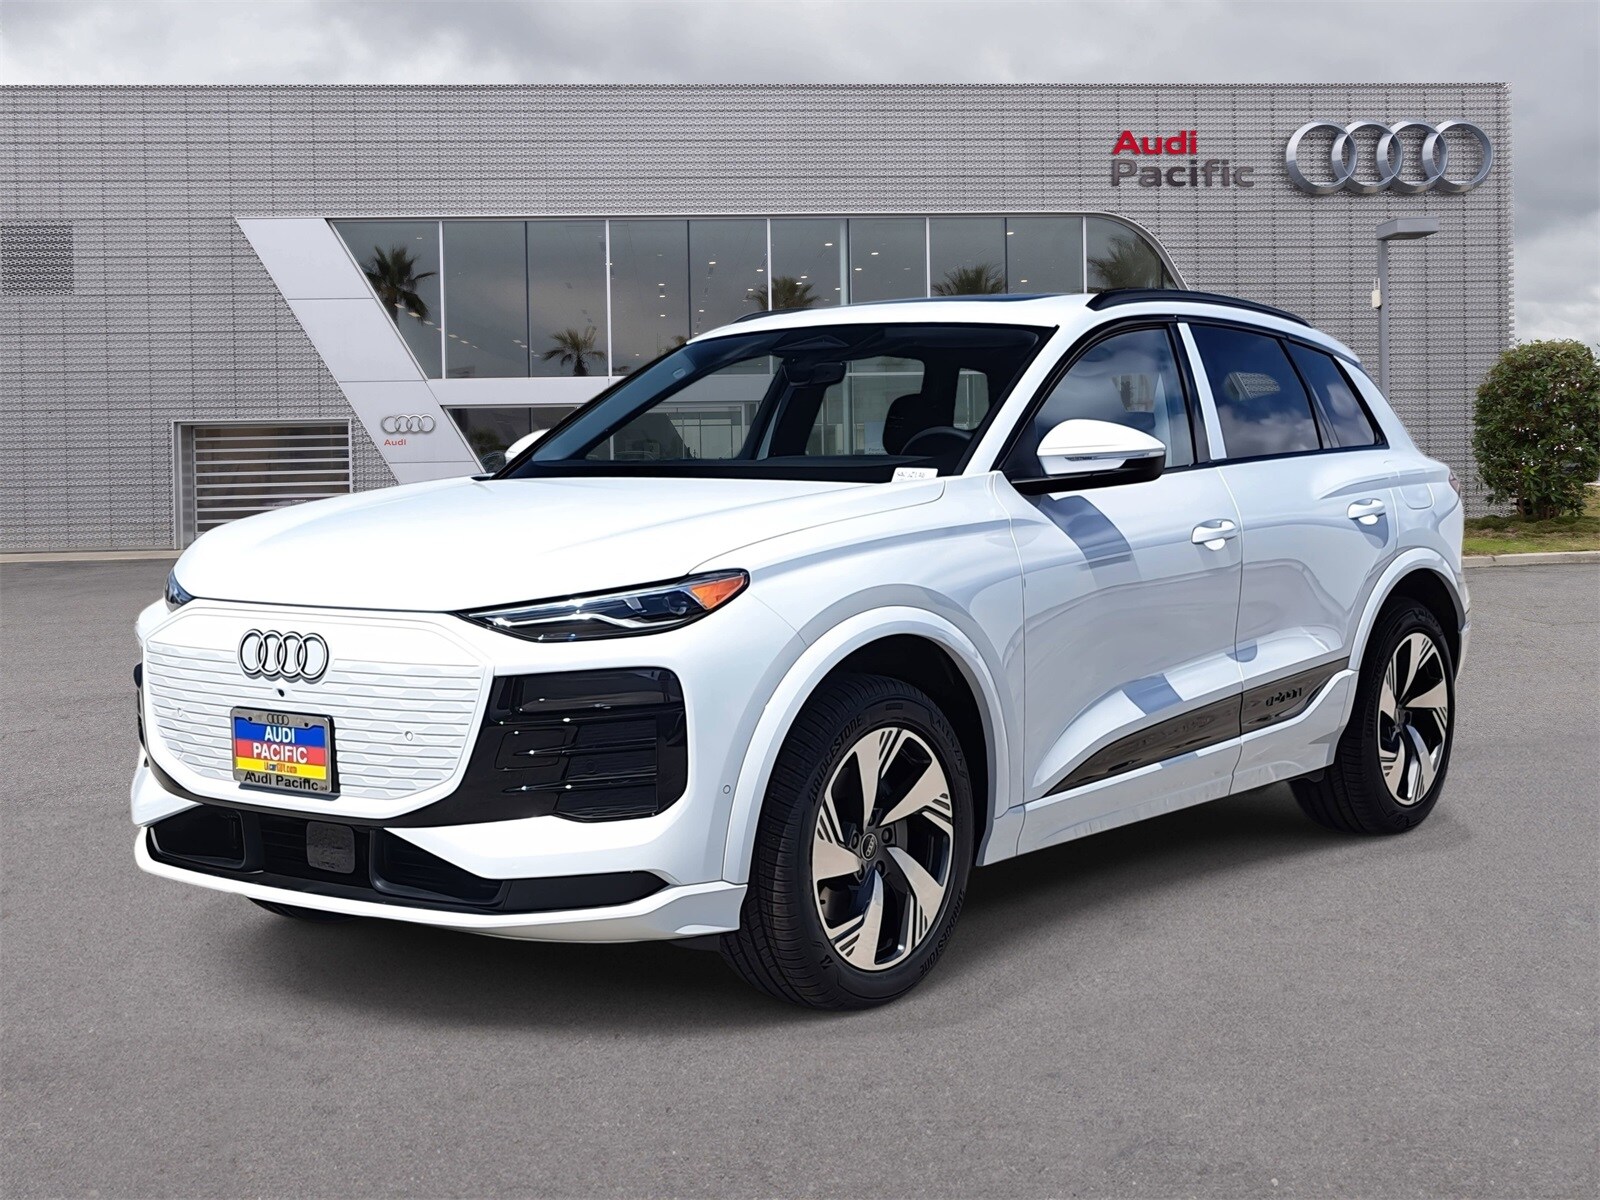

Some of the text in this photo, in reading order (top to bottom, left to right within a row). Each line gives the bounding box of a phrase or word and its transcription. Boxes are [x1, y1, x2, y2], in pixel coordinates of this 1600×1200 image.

[1112, 130, 1197, 155] Audi
[1111, 159, 1255, 187] Pacific
[264, 726, 296, 744] AUDI
[252, 742, 308, 764] PACIFIC
[244, 771, 272, 785] Audi
[276, 775, 319, 791] Pacific
